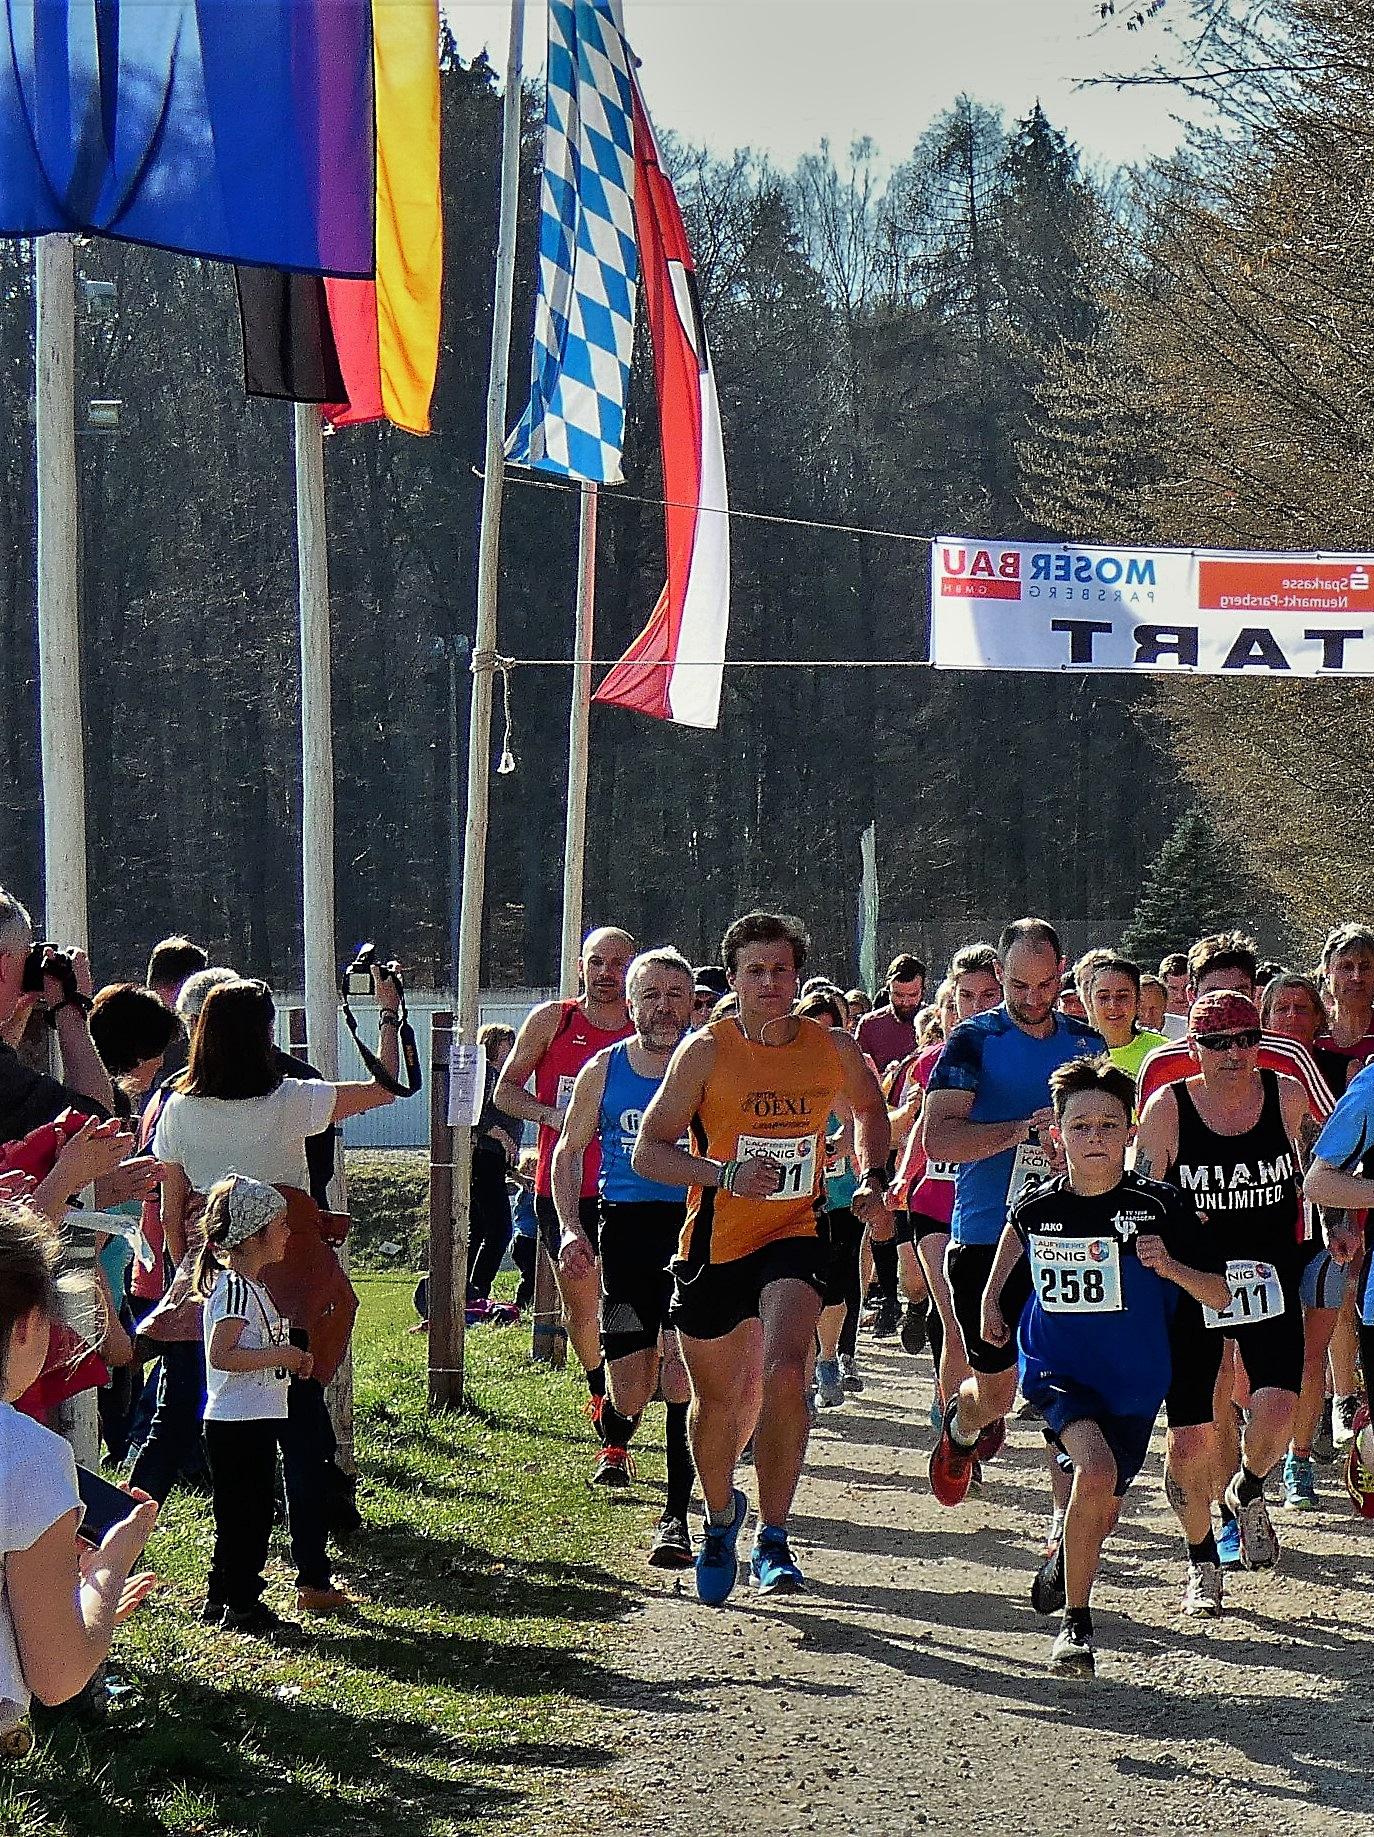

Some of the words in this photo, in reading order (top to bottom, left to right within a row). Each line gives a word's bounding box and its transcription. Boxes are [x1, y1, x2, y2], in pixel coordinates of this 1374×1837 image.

[744, 1147, 795, 1158] KÖNIG
[1022, 1156, 1050, 1167] KÖN
[1180, 1153, 1293, 1191] MIAMI
[1195, 1185, 1284, 1210] UNLIMITED.
[1040, 1222, 1063, 1232] JAKO
[1034, 1248, 1086, 1261] KÖNIG
[1228, 1270, 1254, 1281] NIG
[1040, 1268, 1105, 1303] 258
